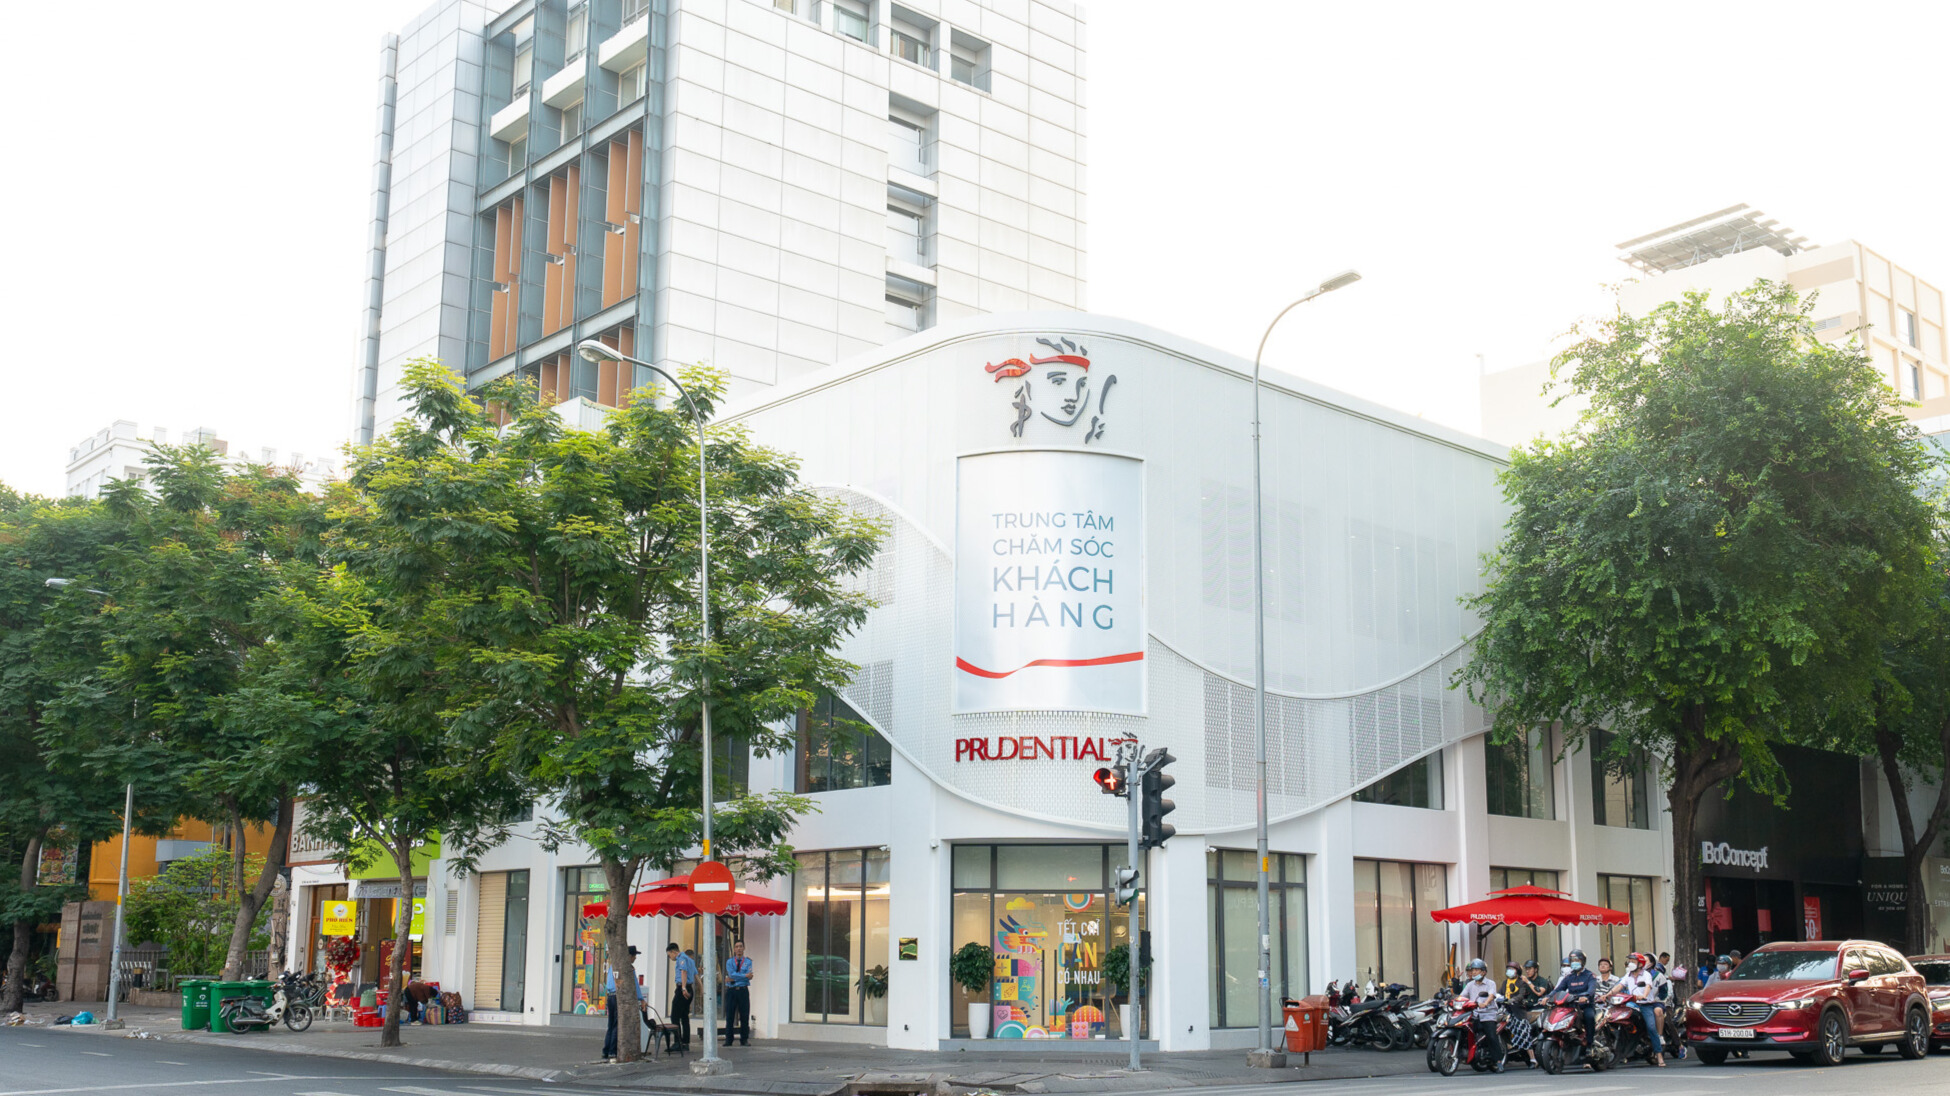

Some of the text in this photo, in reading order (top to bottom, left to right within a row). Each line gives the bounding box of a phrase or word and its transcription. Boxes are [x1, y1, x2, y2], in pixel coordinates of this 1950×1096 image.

[992, 510, 1114, 532] TRUNG TÂM
[993, 533, 1114, 558] CHĂM SÓC
[993, 559, 1113, 594] KHÁCH
[993, 595, 1113, 630] HÀNG
[955, 736, 1111, 762] PRUDENTIAL
[1702, 841, 1768, 873] BoConcept
[1057, 918, 1101, 936] TẾT CHỈ
[1057, 967, 1100, 984] CÓ NHAU
